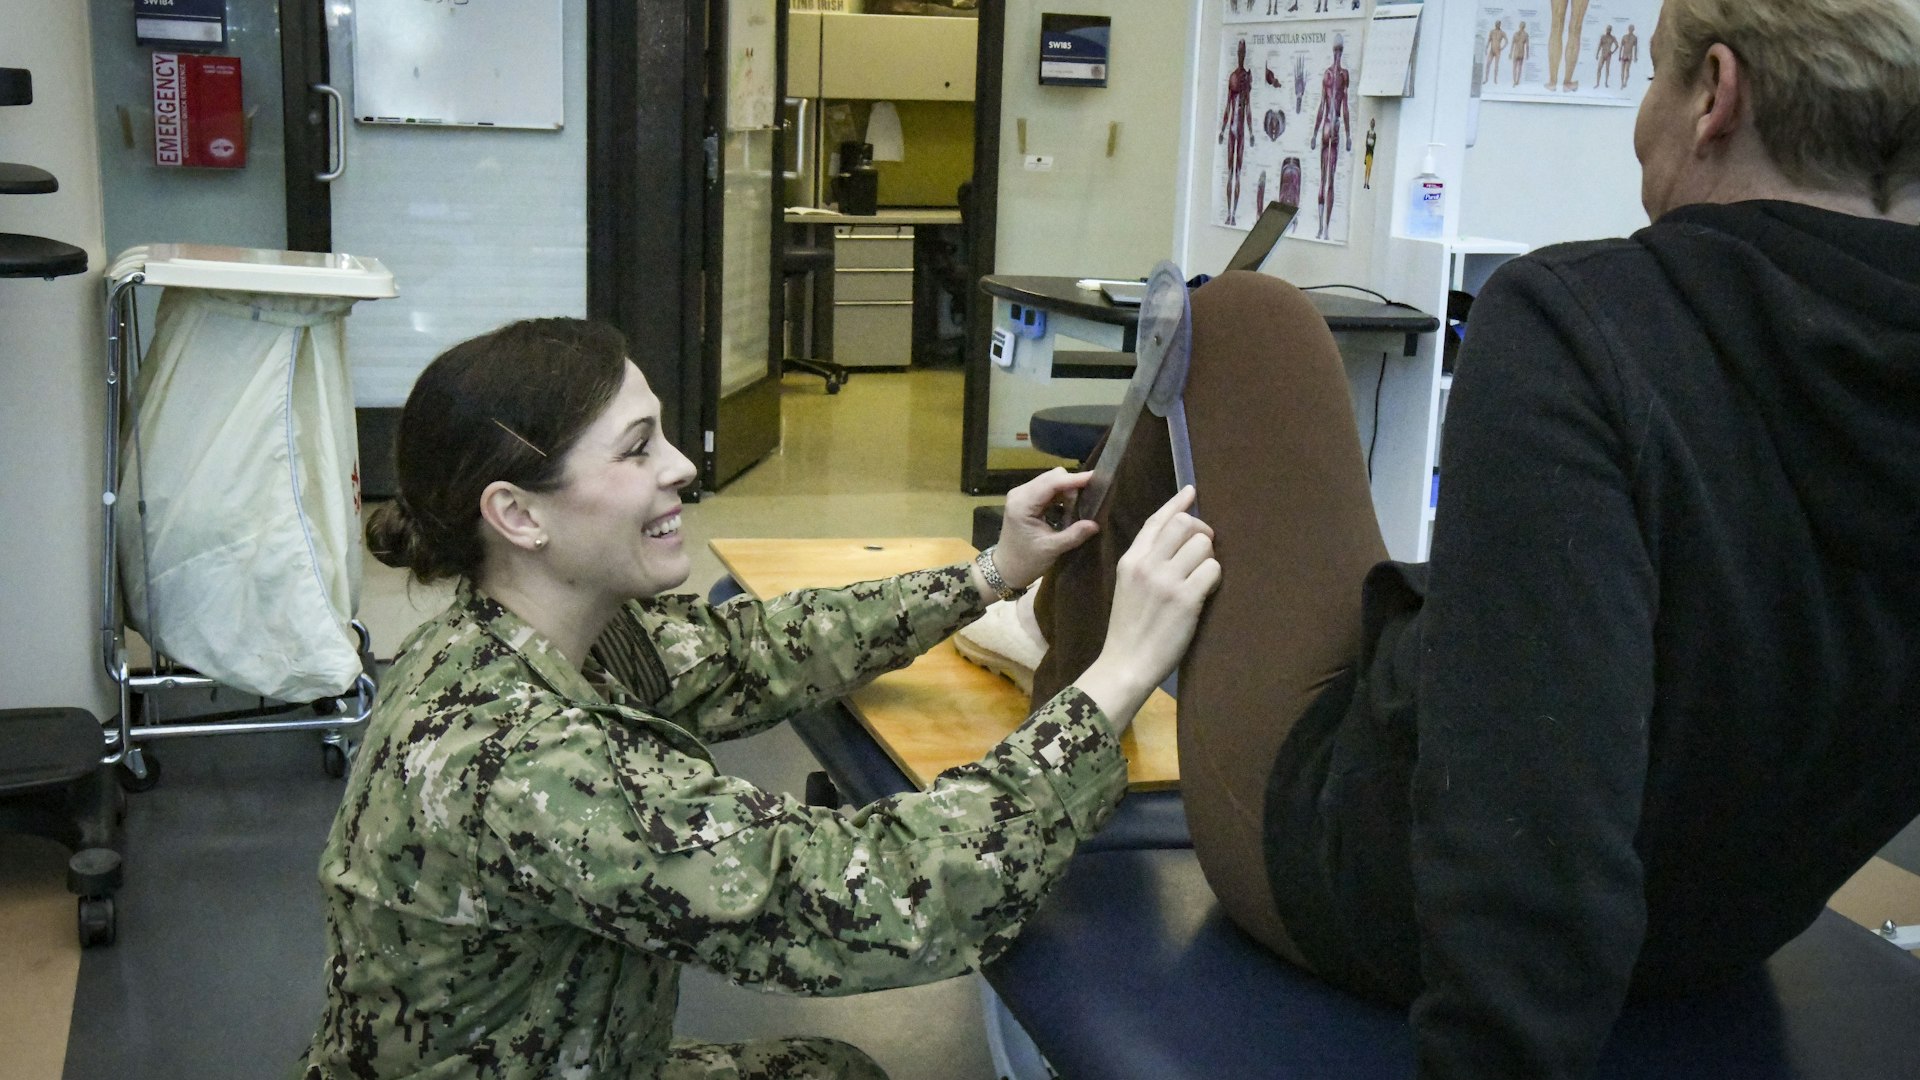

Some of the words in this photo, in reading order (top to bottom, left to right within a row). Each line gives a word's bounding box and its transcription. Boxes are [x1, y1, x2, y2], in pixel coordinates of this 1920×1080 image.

[1048, 41, 1072, 49] SW185
[1253, 34, 1265, 45] THE
[1266, 33, 1301, 44] MUSCULAR
[1301, 32, 1327, 44] SYSTEM
[155, 55, 179, 163] EMERGENCY
